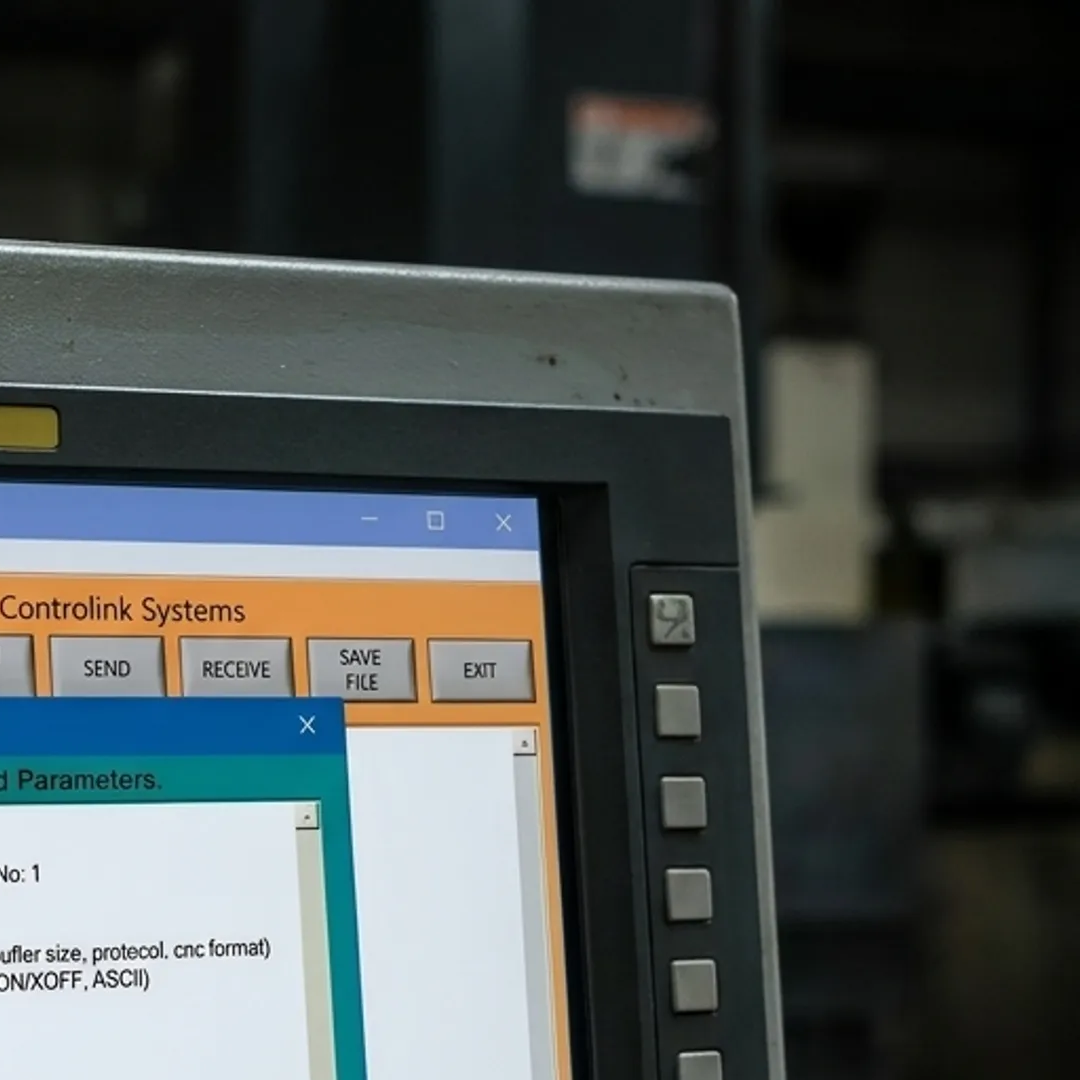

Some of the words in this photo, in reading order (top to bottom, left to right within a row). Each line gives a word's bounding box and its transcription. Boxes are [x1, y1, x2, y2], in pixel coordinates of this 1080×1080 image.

[0, 595, 133, 621] Controlink
[142, 597, 246, 627] Systems
[339, 649, 381, 666] SAVE
[84, 660, 131, 678] SEND
[202, 660, 271, 679] RECEIVE
[464, 662, 497, 679] EXIT
[346, 673, 378, 691] FILE
[18, 769, 162, 791] Parameters.
[32, 864, 40, 882] 1
[173, 943, 205, 959] cnc
[209, 937, 271, 960] format)
[92, 968, 150, 992] ASCII)
